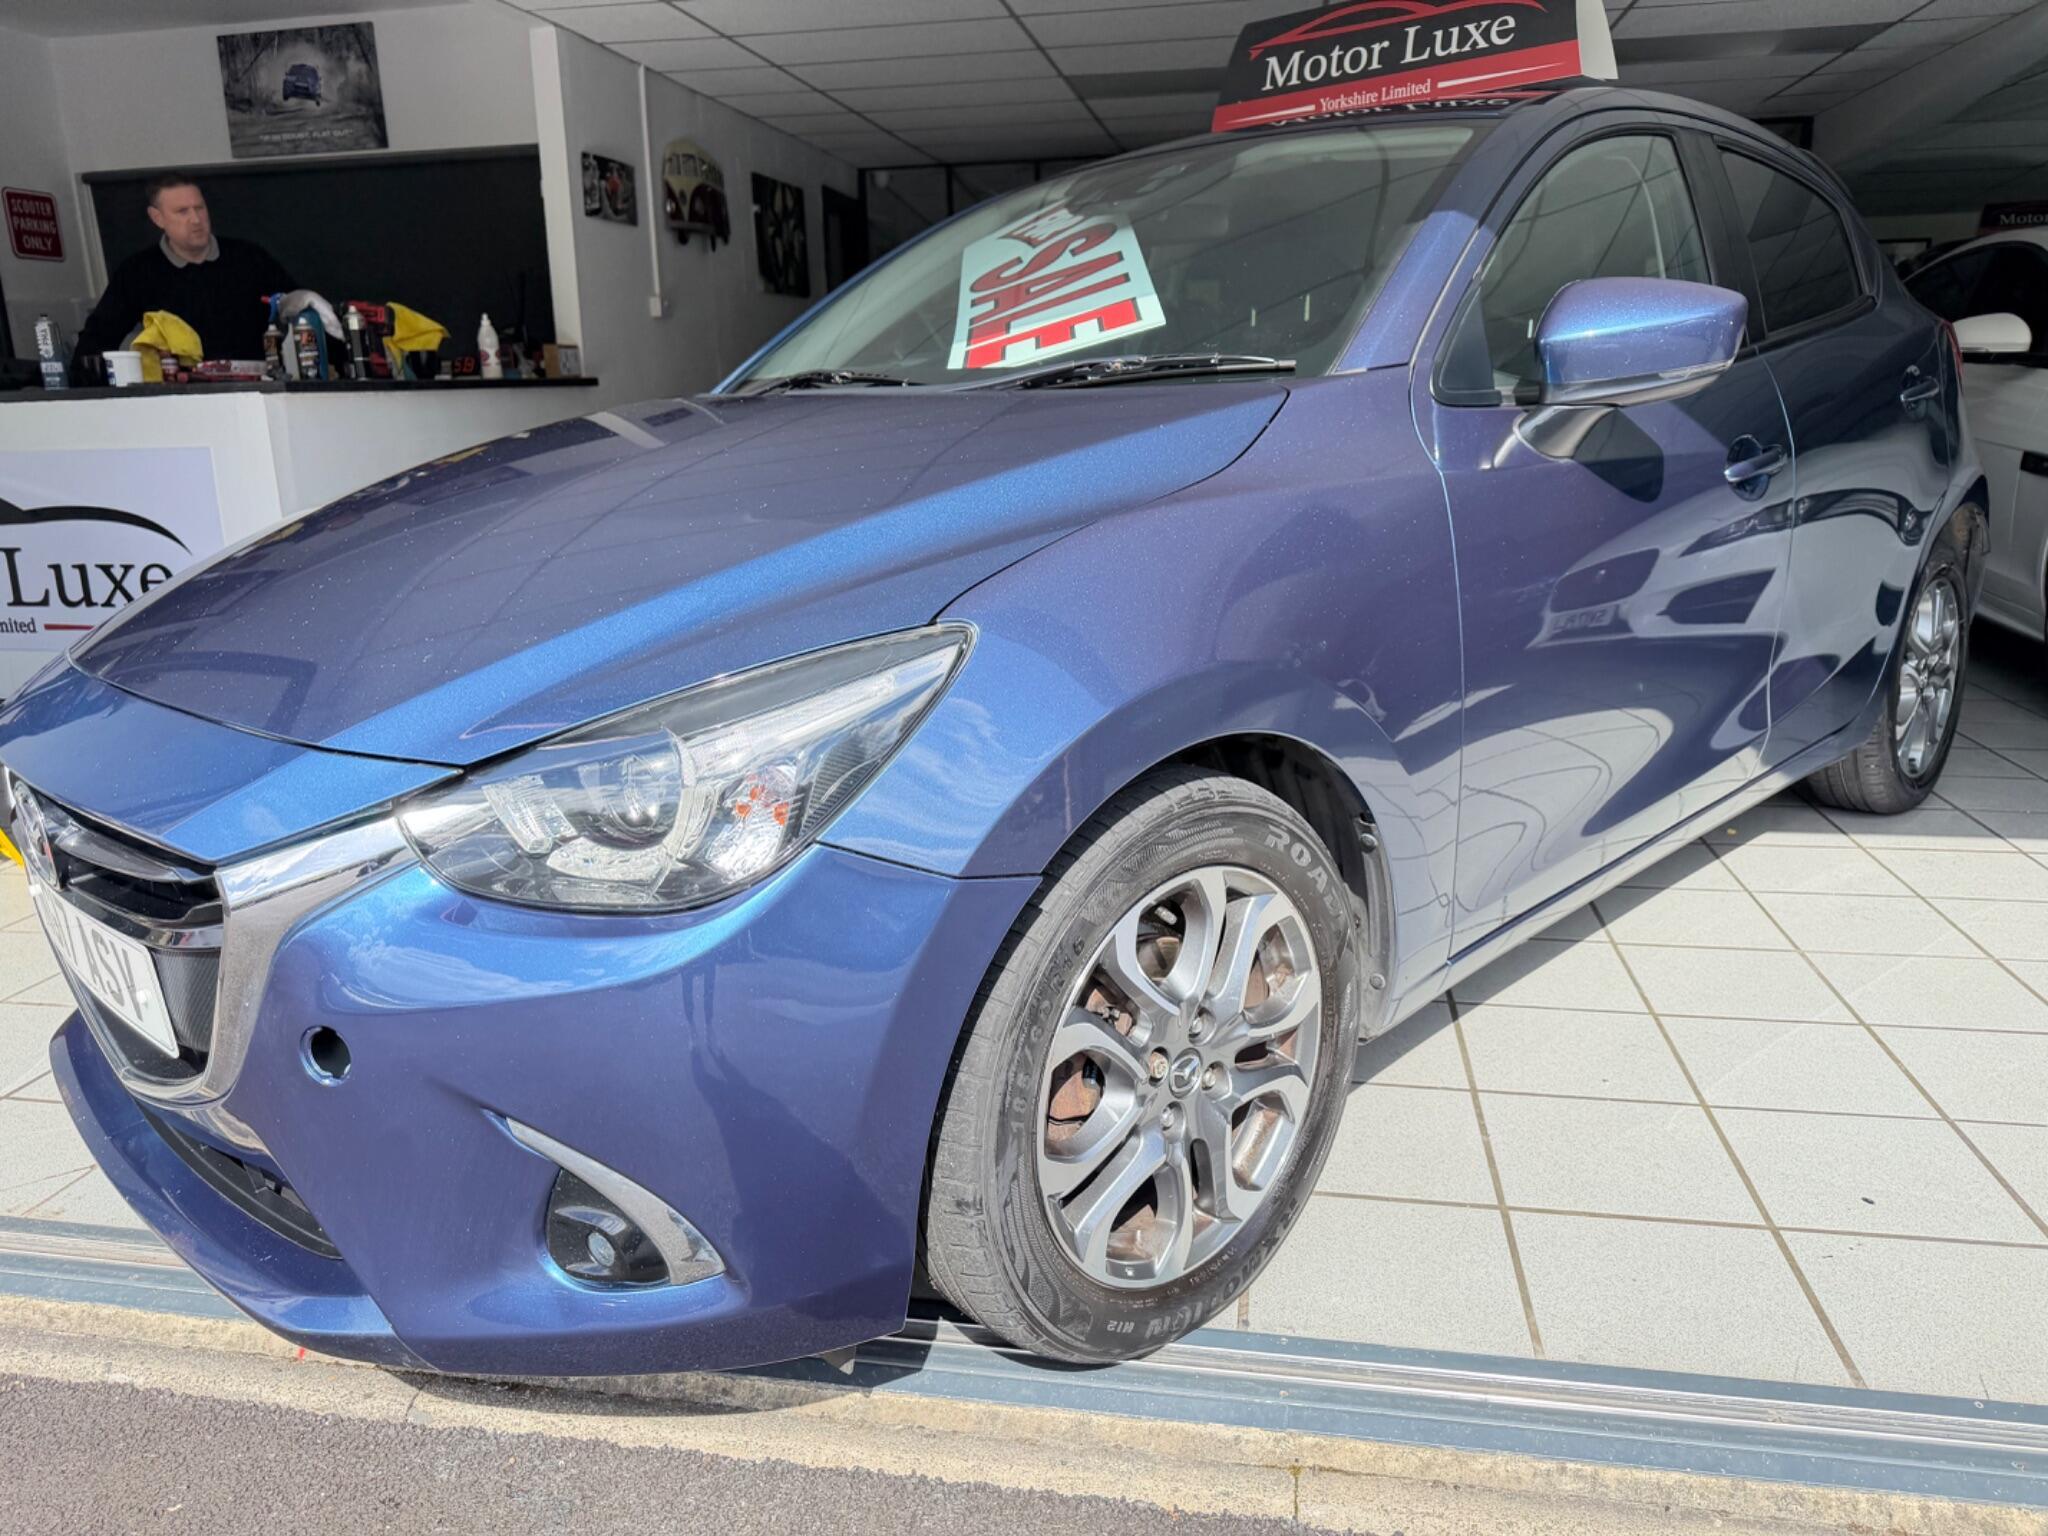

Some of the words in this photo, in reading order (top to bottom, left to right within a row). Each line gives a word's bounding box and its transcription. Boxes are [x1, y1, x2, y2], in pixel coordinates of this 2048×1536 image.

[1261, 40, 1390, 92] Motor
[1400, 13, 1516, 64] Luxe
[1319, 89, 1378, 113] Yorkshire
[1382, 79, 1431, 103] Limited
[11, 197, 53, 216] SCOOTER
[13, 215, 57, 235] PARKING
[23, 235, 52, 251] ONLY
[965, 222, 1143, 369] SALE
[0, 547, 174, 609] Luxe
[75, 914, 144, 1022] ASV
